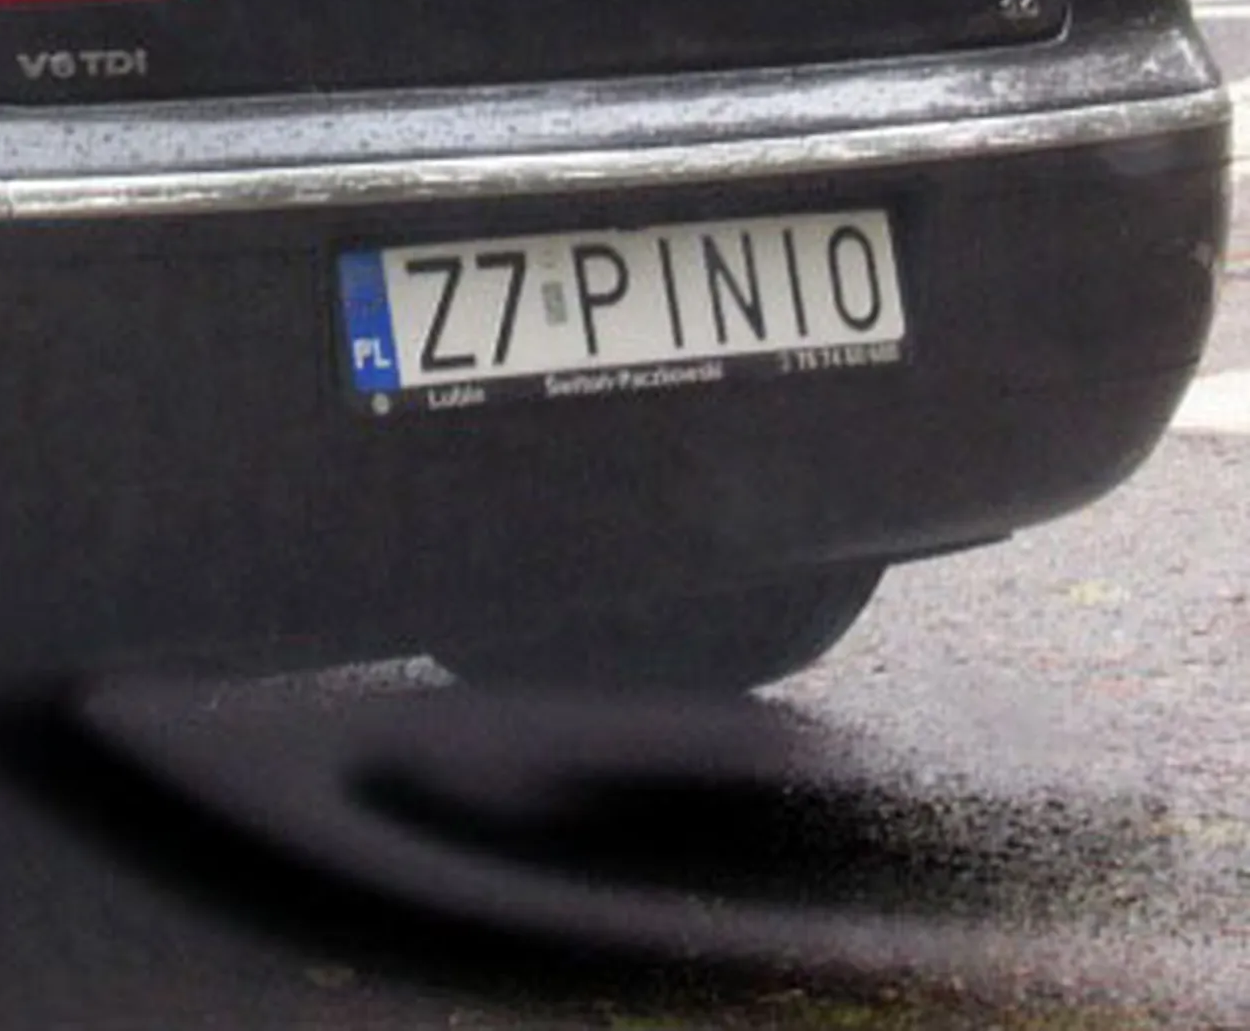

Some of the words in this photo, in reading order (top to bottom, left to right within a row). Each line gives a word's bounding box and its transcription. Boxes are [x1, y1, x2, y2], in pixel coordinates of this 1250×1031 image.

[16, 51, 76, 79] V6
[405, 250, 527, 373] Z7
[572, 225, 882, 356] PINIO
[353, 338, 391, 370] PL
